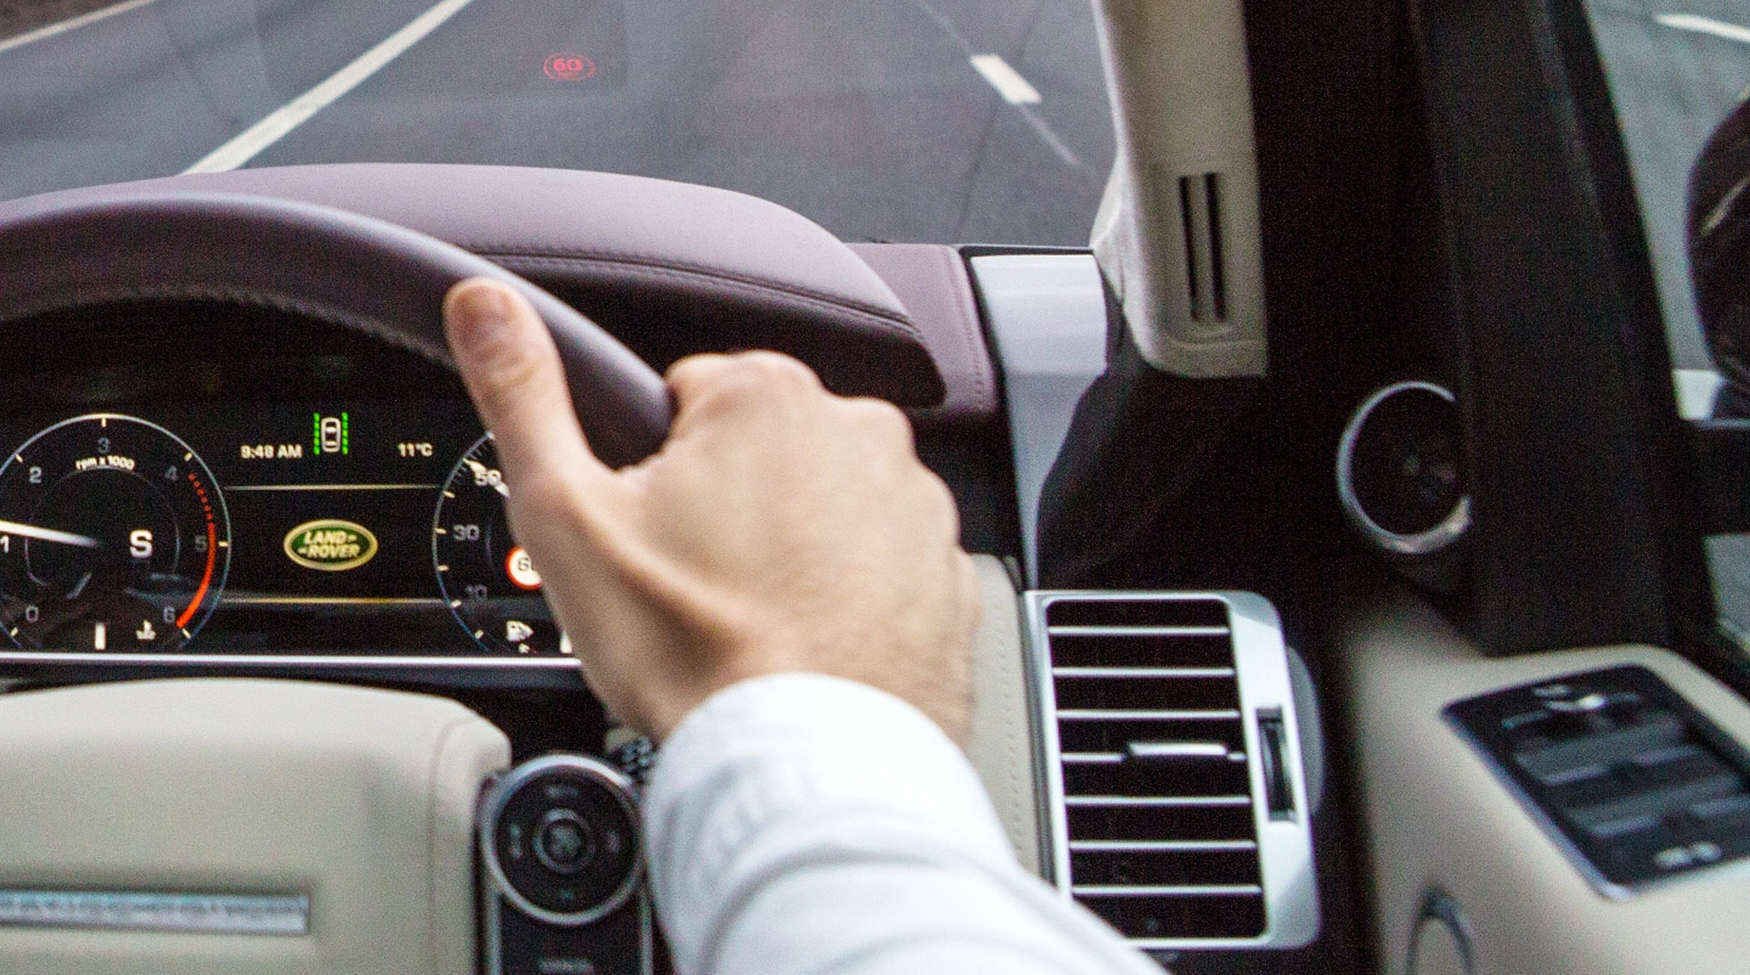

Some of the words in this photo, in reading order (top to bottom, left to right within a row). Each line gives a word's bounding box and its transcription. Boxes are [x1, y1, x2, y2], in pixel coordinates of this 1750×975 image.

[553, 58, 582, 71] 60
[98, 437, 110, 453] 3
[277, 443, 303, 459] AM
[75, 456, 98, 471] rpm
[107, 454, 135, 471] 1000
[29, 467, 42, 484] 2
[165, 466, 178, 481] 4
[453, 525, 480, 541] 30
[0, 536, 10, 553] 1
[129, 529, 153, 558] S
[25, 606, 39, 622] 0
[163, 607, 176, 624] 6
